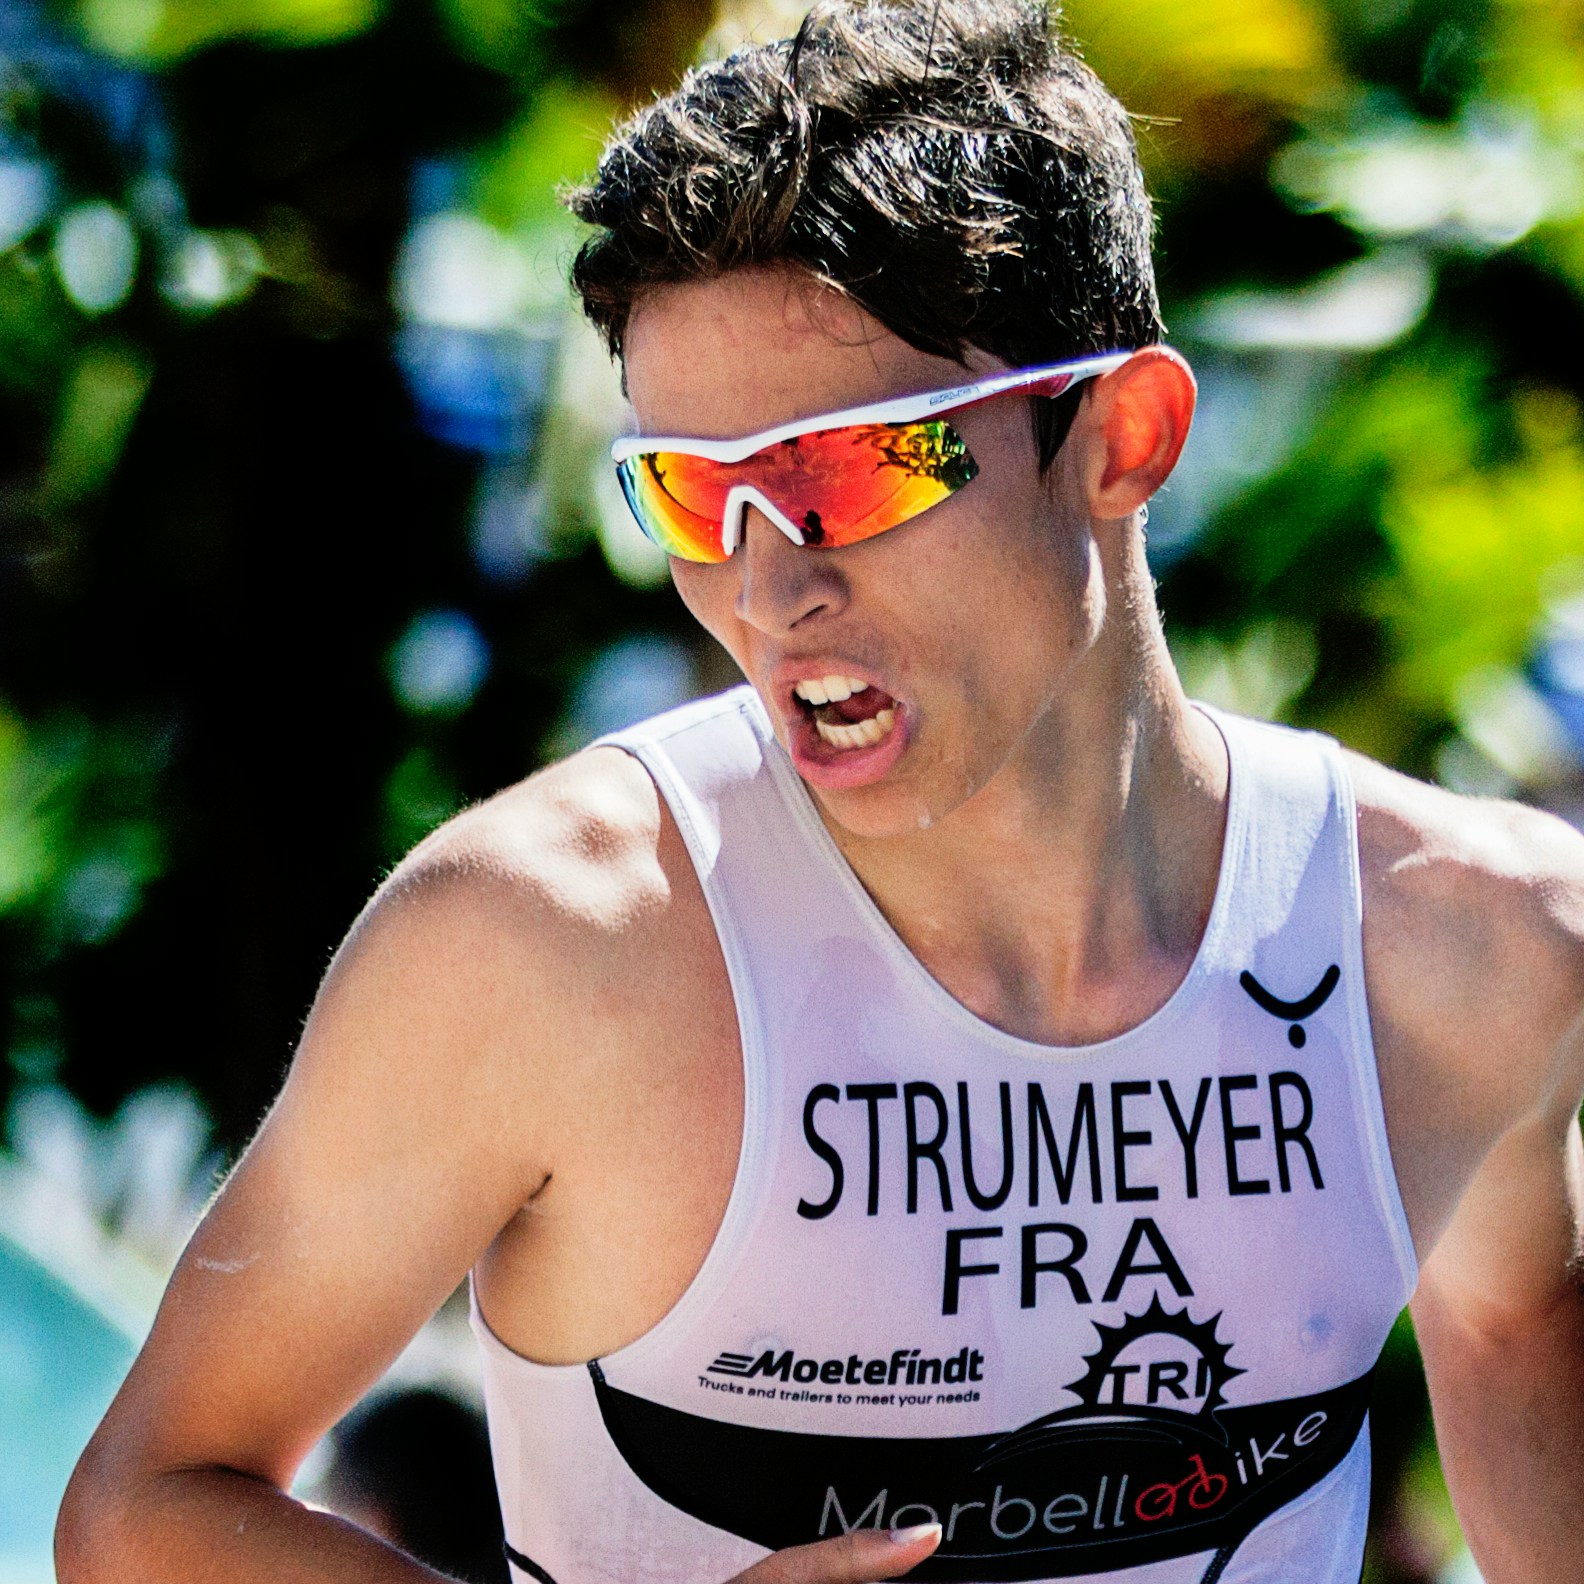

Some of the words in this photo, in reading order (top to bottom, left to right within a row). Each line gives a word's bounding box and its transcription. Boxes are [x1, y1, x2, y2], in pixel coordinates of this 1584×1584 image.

[797, 1070, 1325, 1221] STRUMEYER
[941, 1217, 1195, 1316] FRA
[698, 1376, 744, 1395] Trucks
[747, 1387, 777, 1400] and
[780, 1390, 833, 1404] trailers
[837, 1393, 852, 1405] to
[856, 1393, 895, 1406] meet
[899, 1394, 934, 1408] your
[936, 1390, 981, 1404] needs
[1107, 1357, 1211, 1405] TRI
